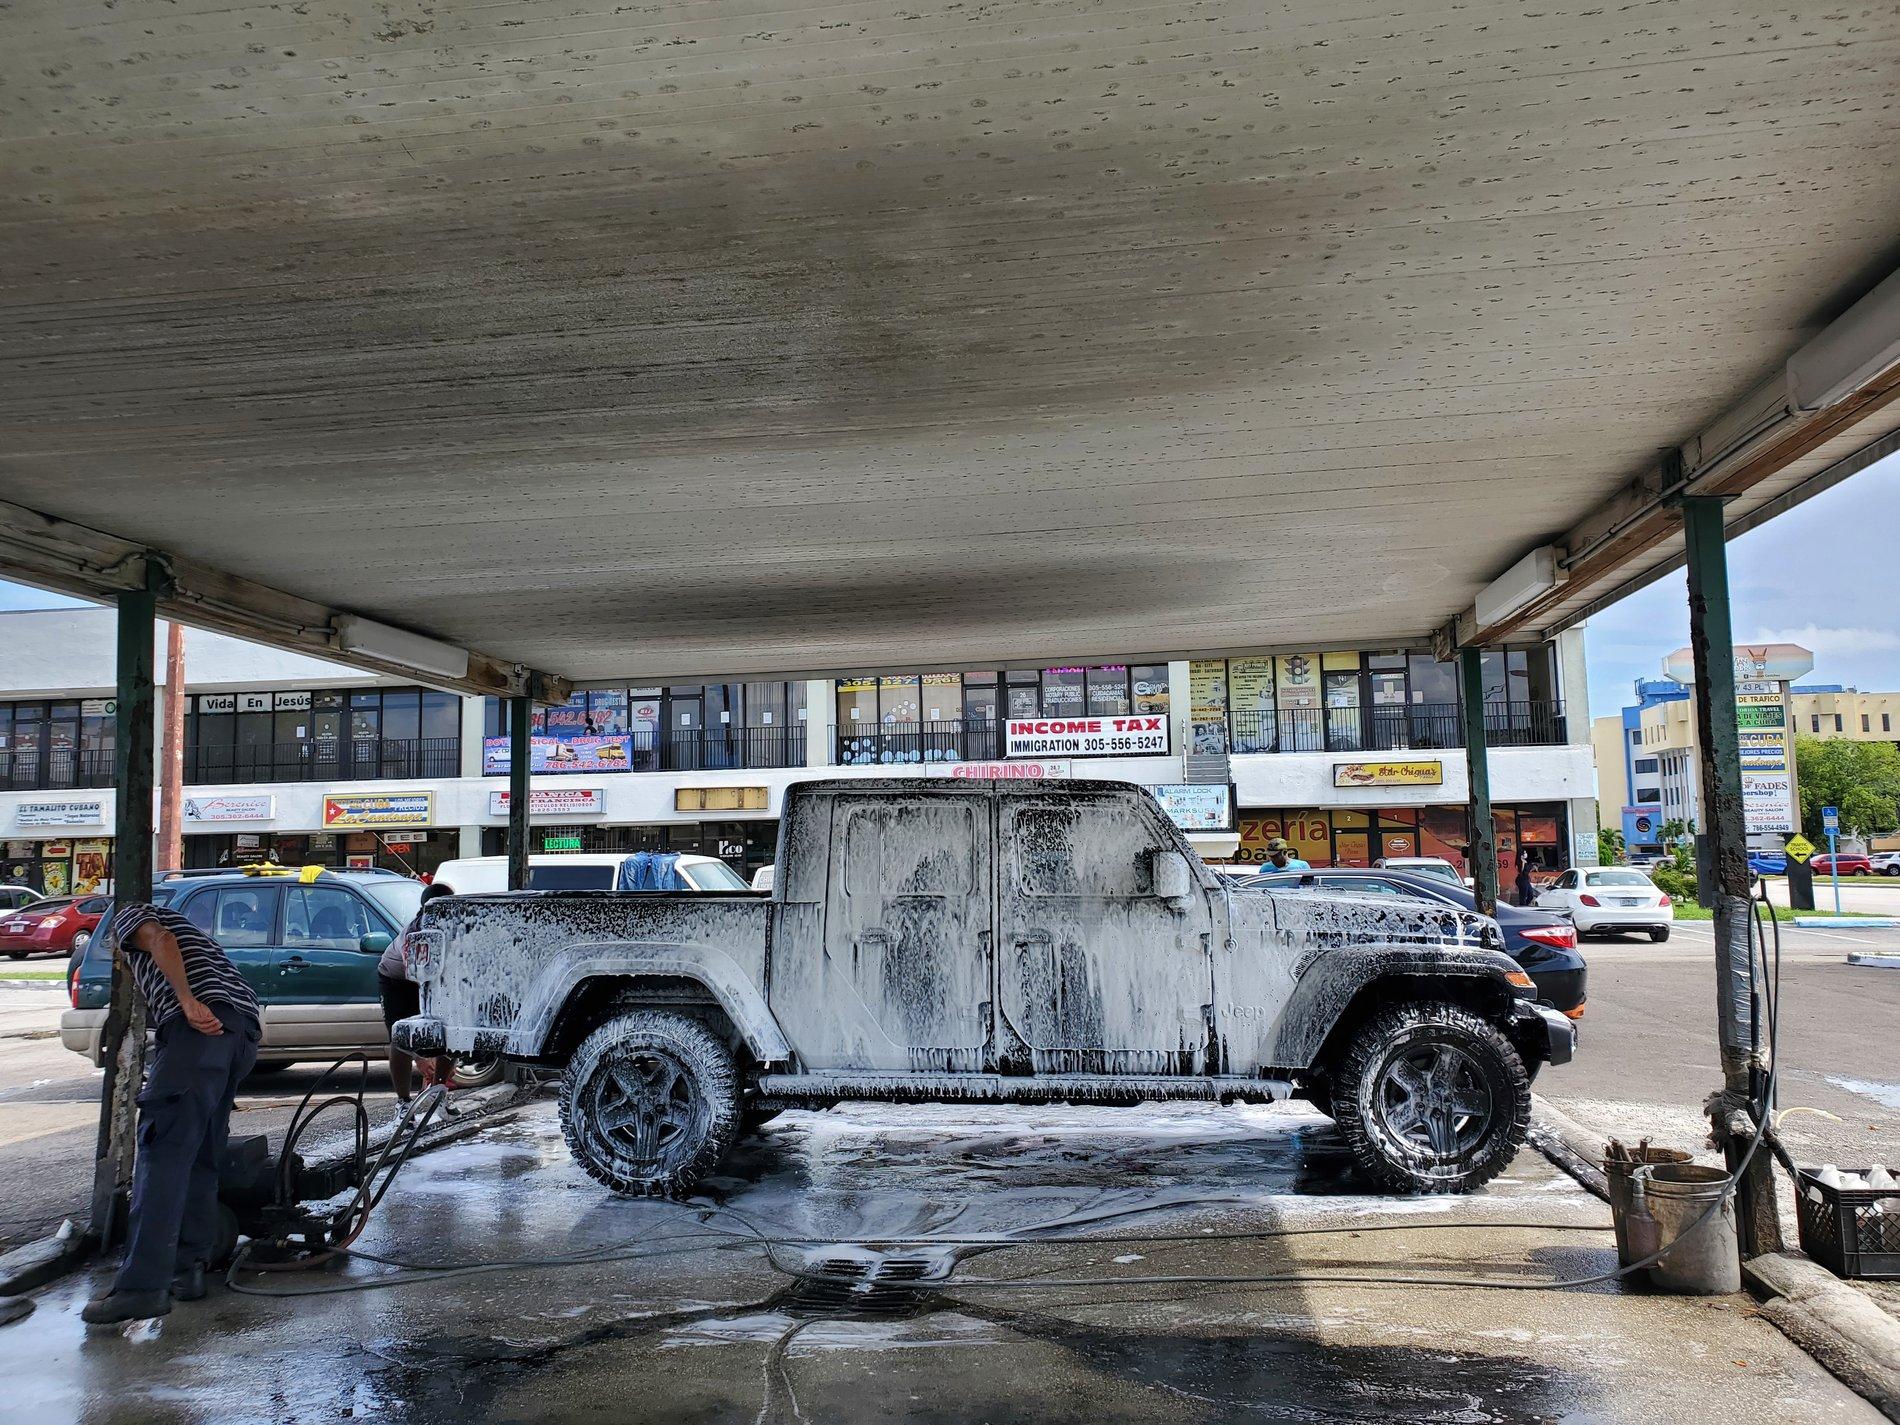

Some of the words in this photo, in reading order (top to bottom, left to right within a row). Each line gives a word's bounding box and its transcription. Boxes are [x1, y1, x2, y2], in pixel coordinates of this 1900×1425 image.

[207, 698, 234, 709] Vida
[247, 698, 263, 708] En
[275, 695, 311, 707] Jesús
[1011, 720, 1102, 735] INCOME
[1113, 718, 1162, 732] TAX
[1011, 738, 1079, 753] IMMIGRATION
[1084, 736, 1164, 751] 305-556-5247
[1749, 734, 1783, 747] CUBA
[952, 762, 1045, 778] CHIRINO
[1754, 781, 1788, 790] FADES
[30, 804, 66, 812] TAMALITO
[69, 803, 100, 811] CUBANO
[544, 838, 581, 849] LECTURA
[1221, 1001, 1265, 1021] Jeep
